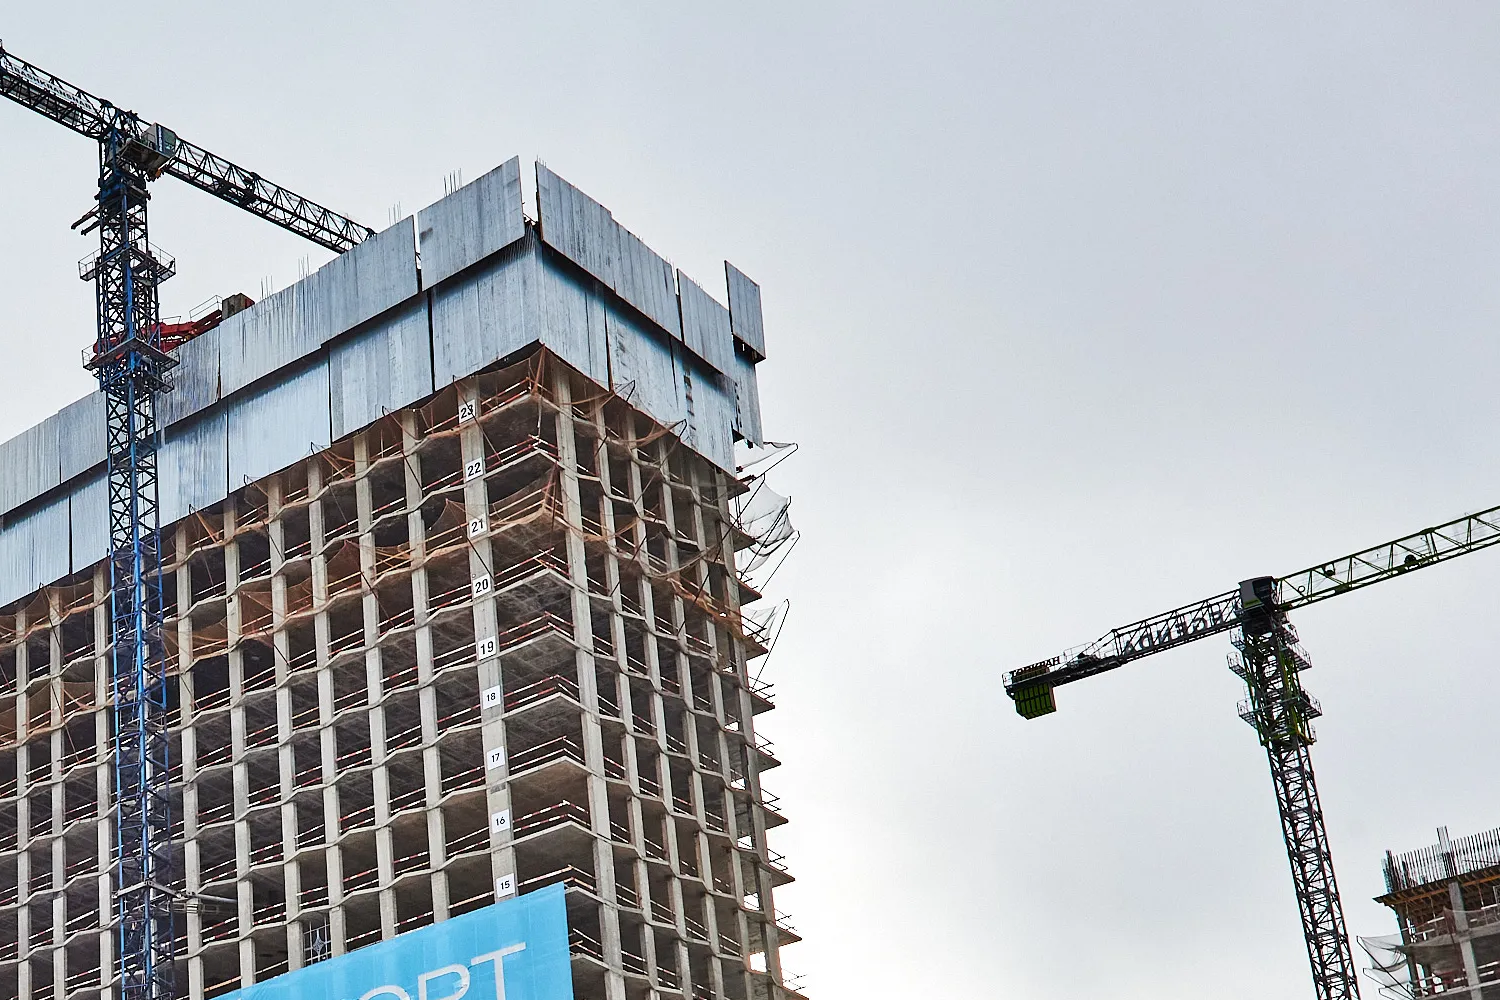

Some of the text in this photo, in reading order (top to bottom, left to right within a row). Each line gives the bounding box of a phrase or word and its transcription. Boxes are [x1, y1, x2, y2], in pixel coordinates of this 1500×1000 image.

[460, 405, 474, 419] 23
[467, 462, 481, 477] 22
[471, 518, 484, 534] 21
[475, 578, 489, 594] 20
[480, 640, 494, 655] 19
[486, 692, 496, 702] 18
[491, 752, 500, 763] 17
[495, 816, 506, 826] 16
[500, 880, 510, 890] 15
